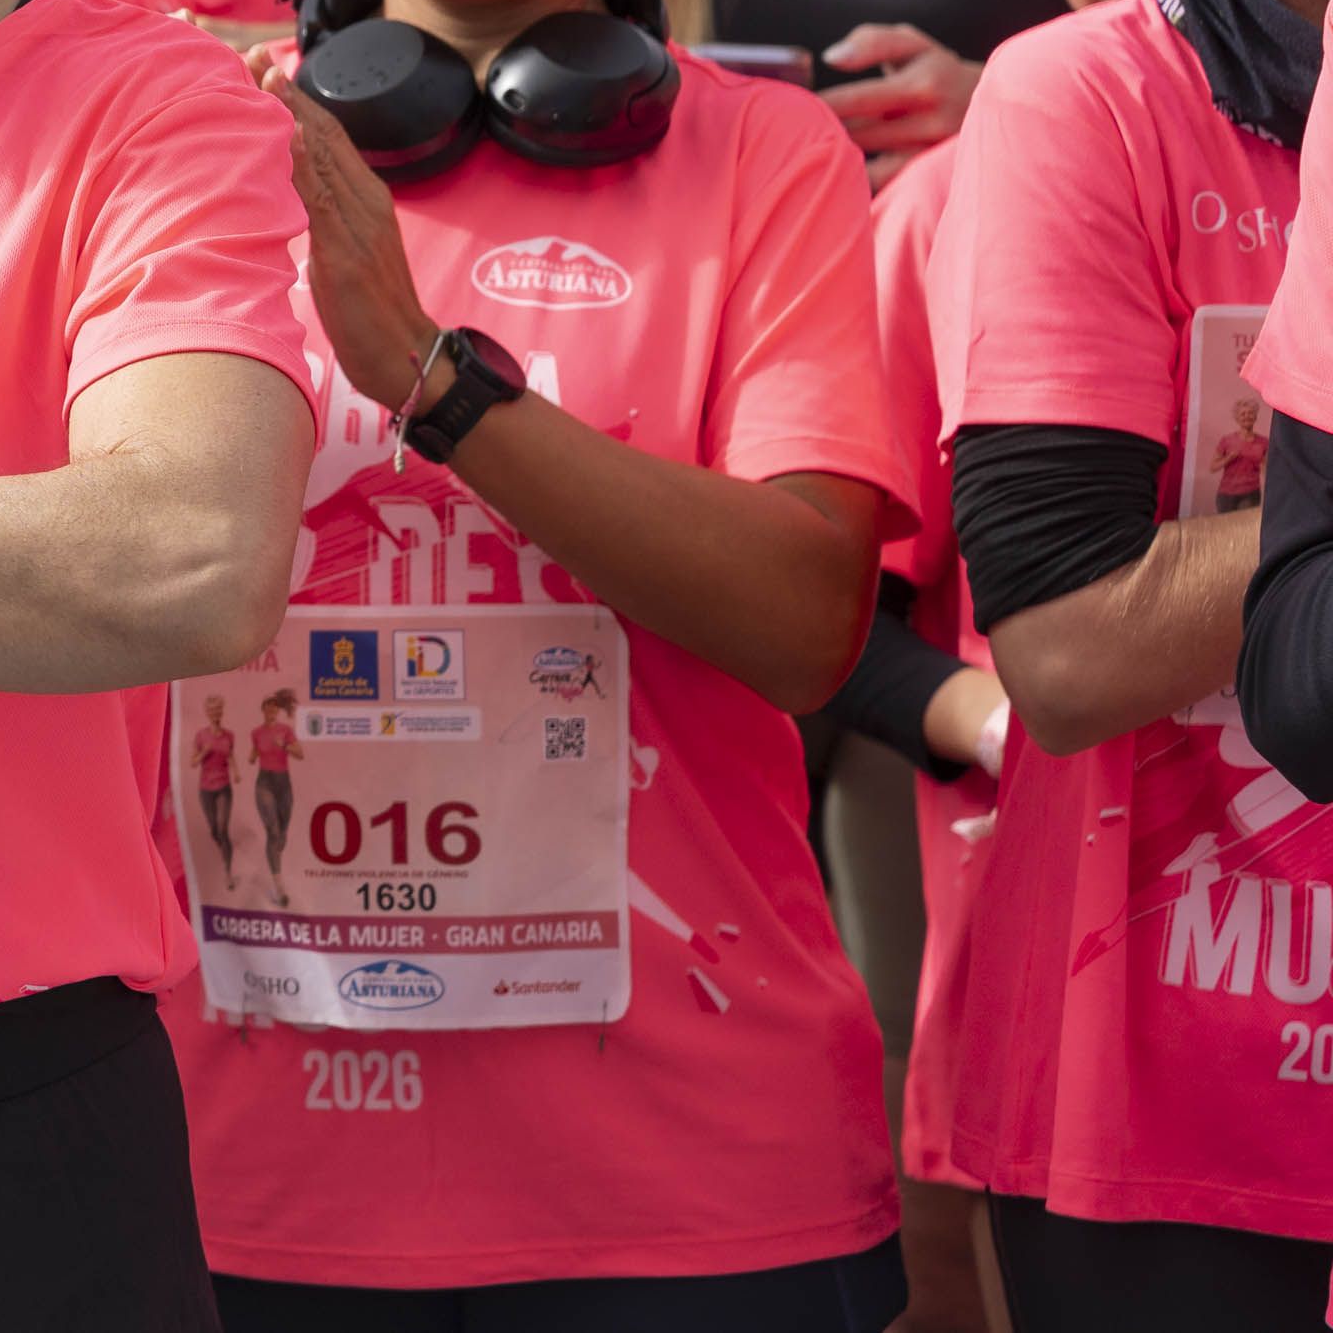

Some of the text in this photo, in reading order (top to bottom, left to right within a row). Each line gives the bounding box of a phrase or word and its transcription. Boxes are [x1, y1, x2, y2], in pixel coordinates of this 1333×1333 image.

[1192, 190, 1296, 253] OSH
[484, 260, 619, 298] ASTURIANA
[308, 800, 482, 866] 016
[356, 882, 437, 912] 1630
[213, 914, 603, 948] CARRERA DE LA MUJER GRAN CANARIA
[347, 977, 438, 998] ASTURIANA
[511, 979, 582, 996] Santander
[1277, 1022, 1333, 1085] 20
[302, 1049, 424, 1111] 2026
